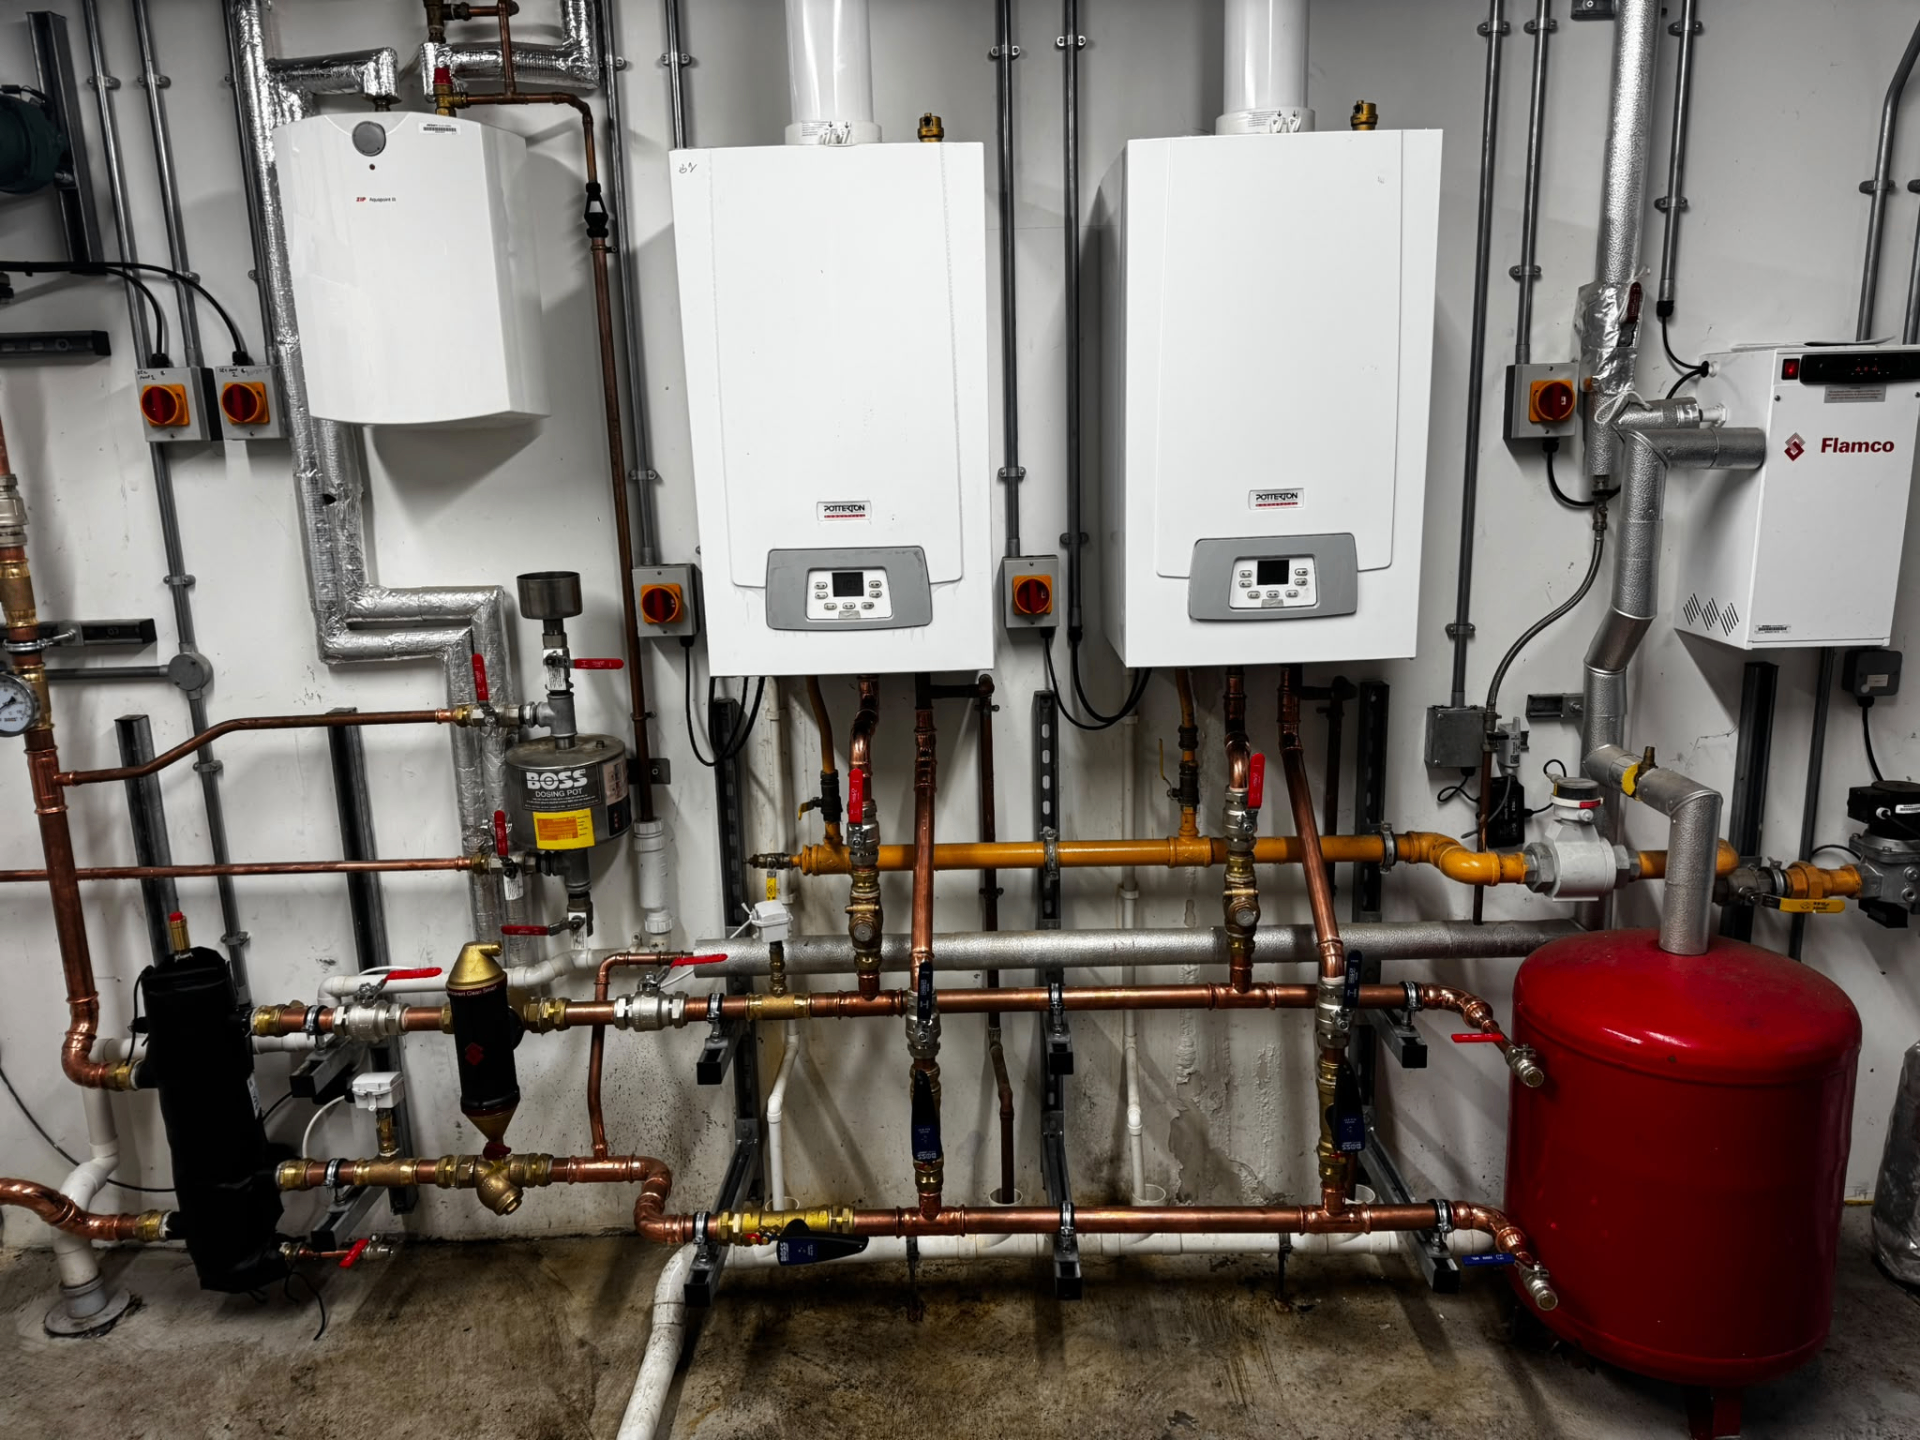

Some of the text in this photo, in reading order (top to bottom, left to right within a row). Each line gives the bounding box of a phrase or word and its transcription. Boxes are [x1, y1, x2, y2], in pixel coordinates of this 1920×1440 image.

[1820, 437, 1895, 453] Flamco
[1255, 492, 1298, 501] POTTERTON
[823, 504, 866, 513] POTTERTON
[526, 768, 588, 790] BOSS
[535, 787, 583, 798] DOSING POT
